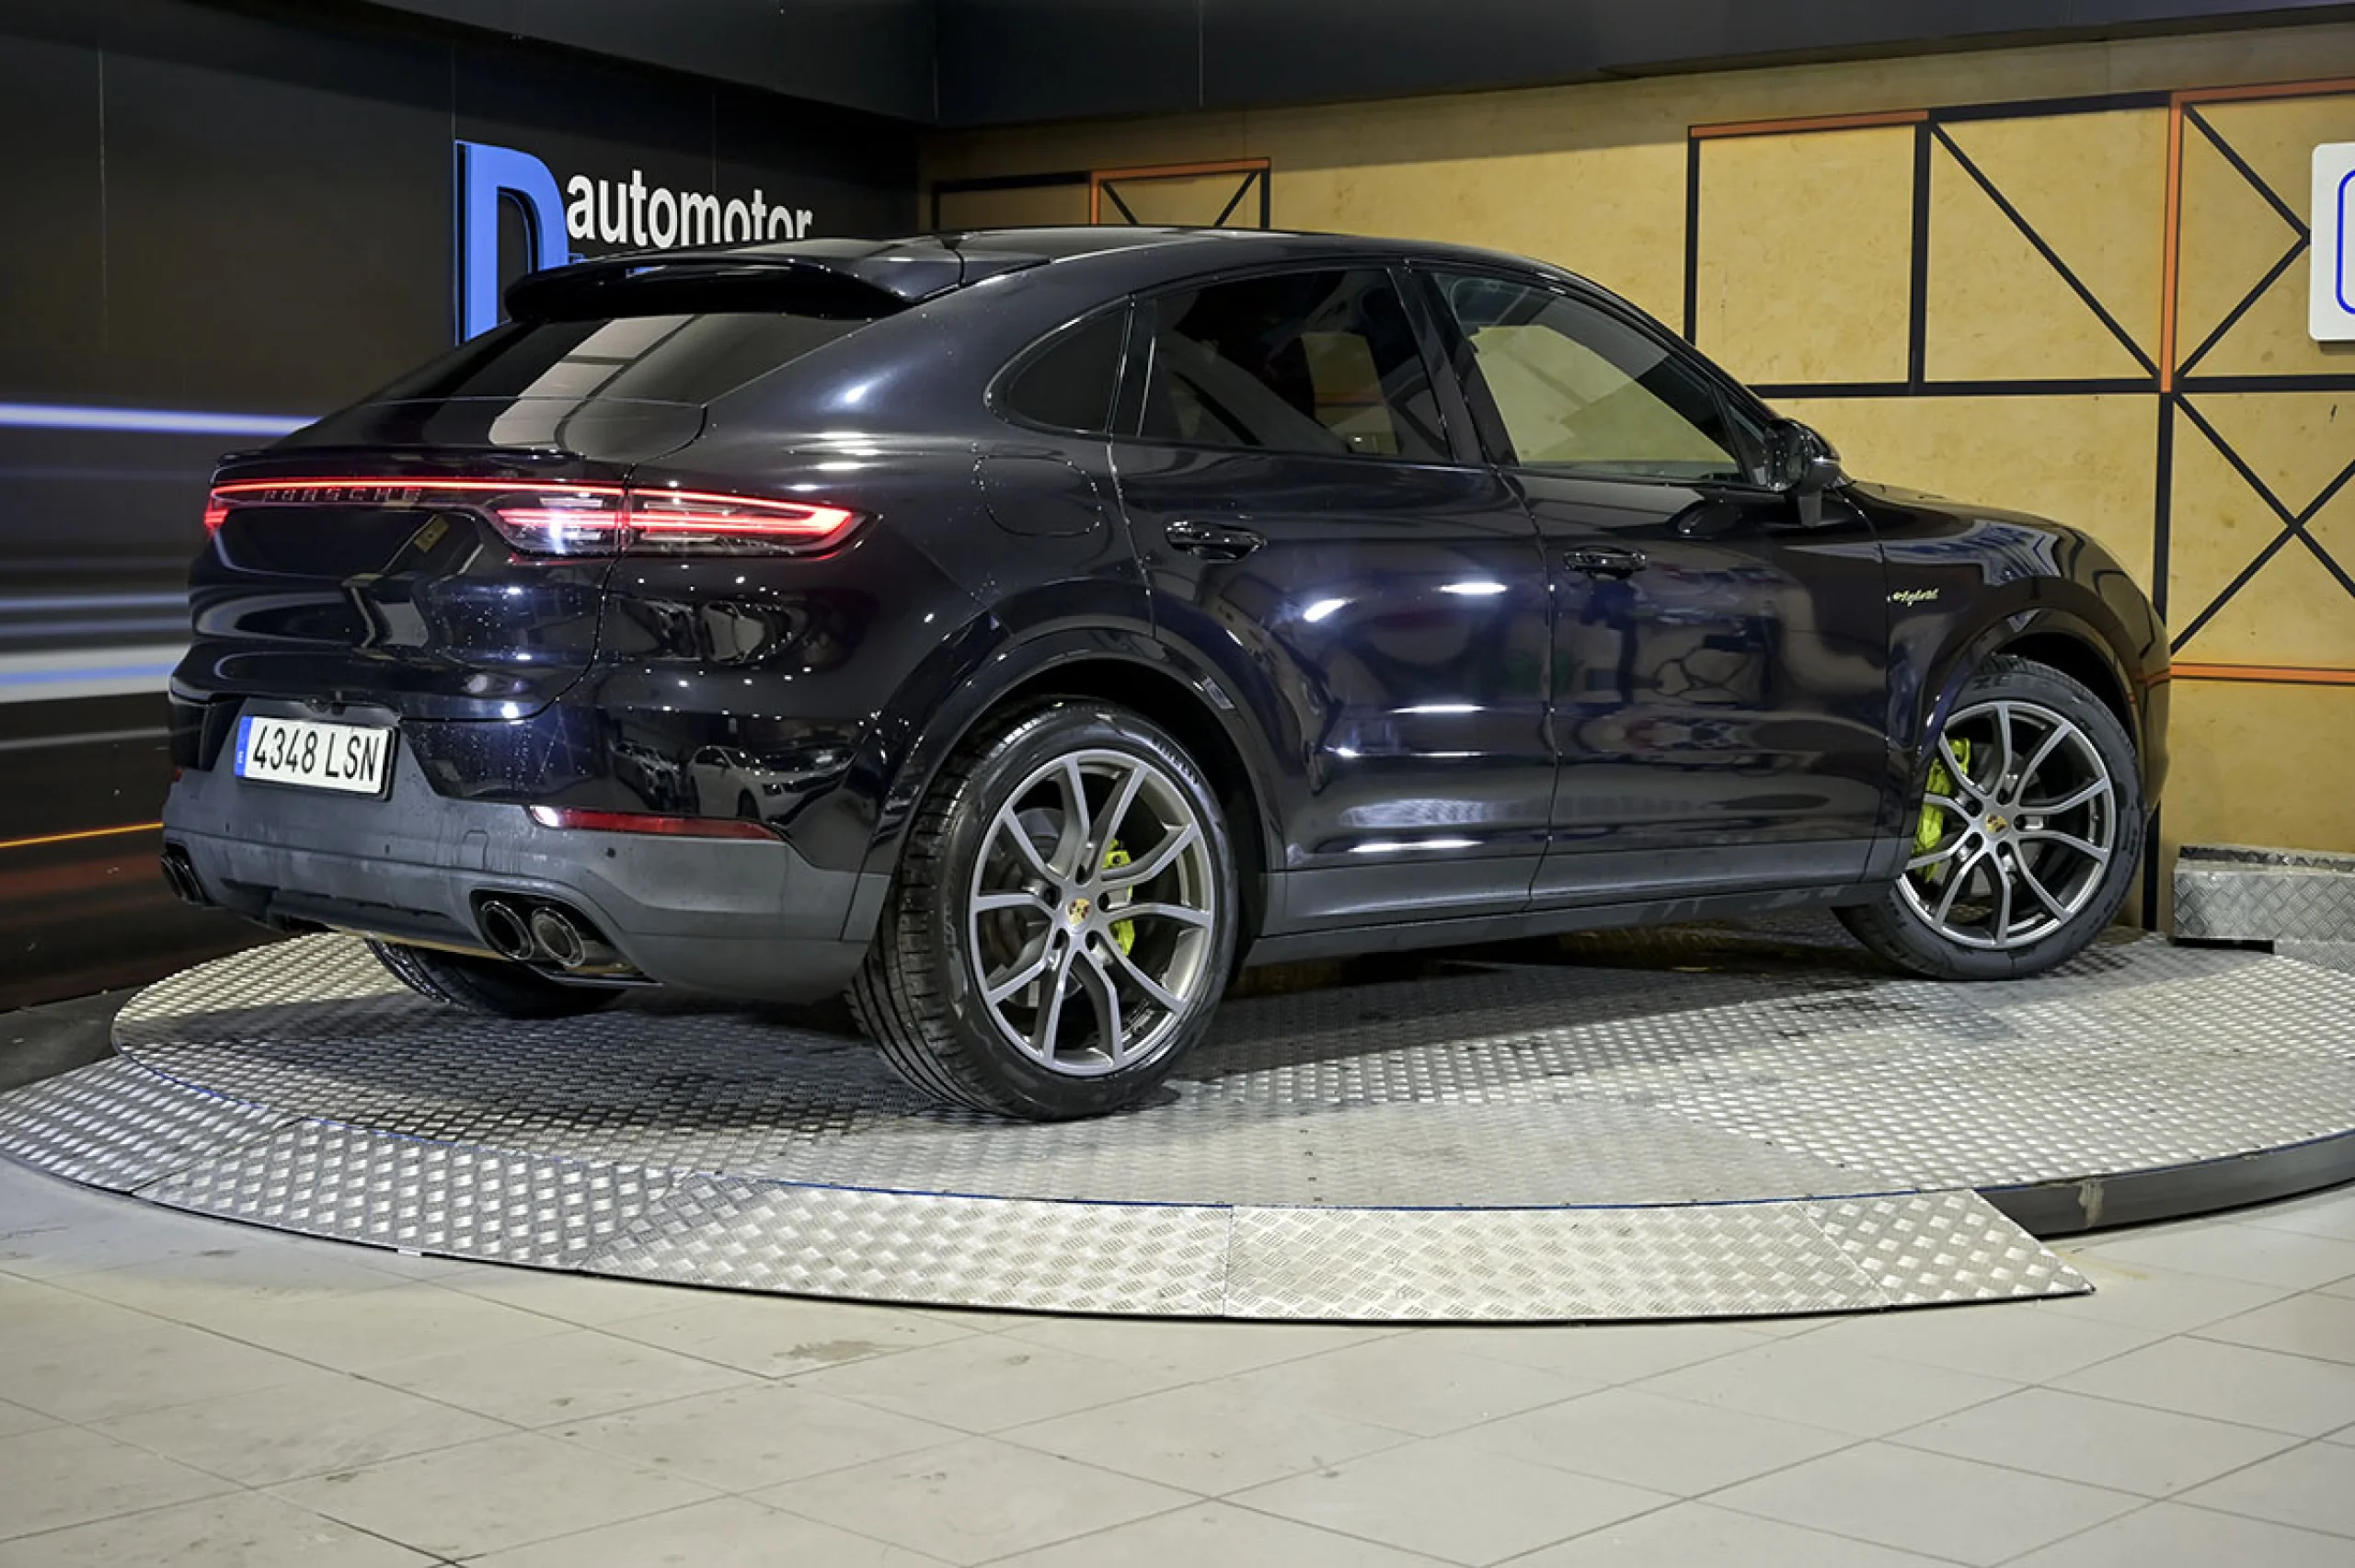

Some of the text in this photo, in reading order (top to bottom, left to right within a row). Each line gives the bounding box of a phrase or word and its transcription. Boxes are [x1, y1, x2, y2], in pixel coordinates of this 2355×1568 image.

[567, 169, 813, 247] automotor
[263, 486, 423, 502] PORSCHE
[252, 725, 380, 781] 4348 LSN
